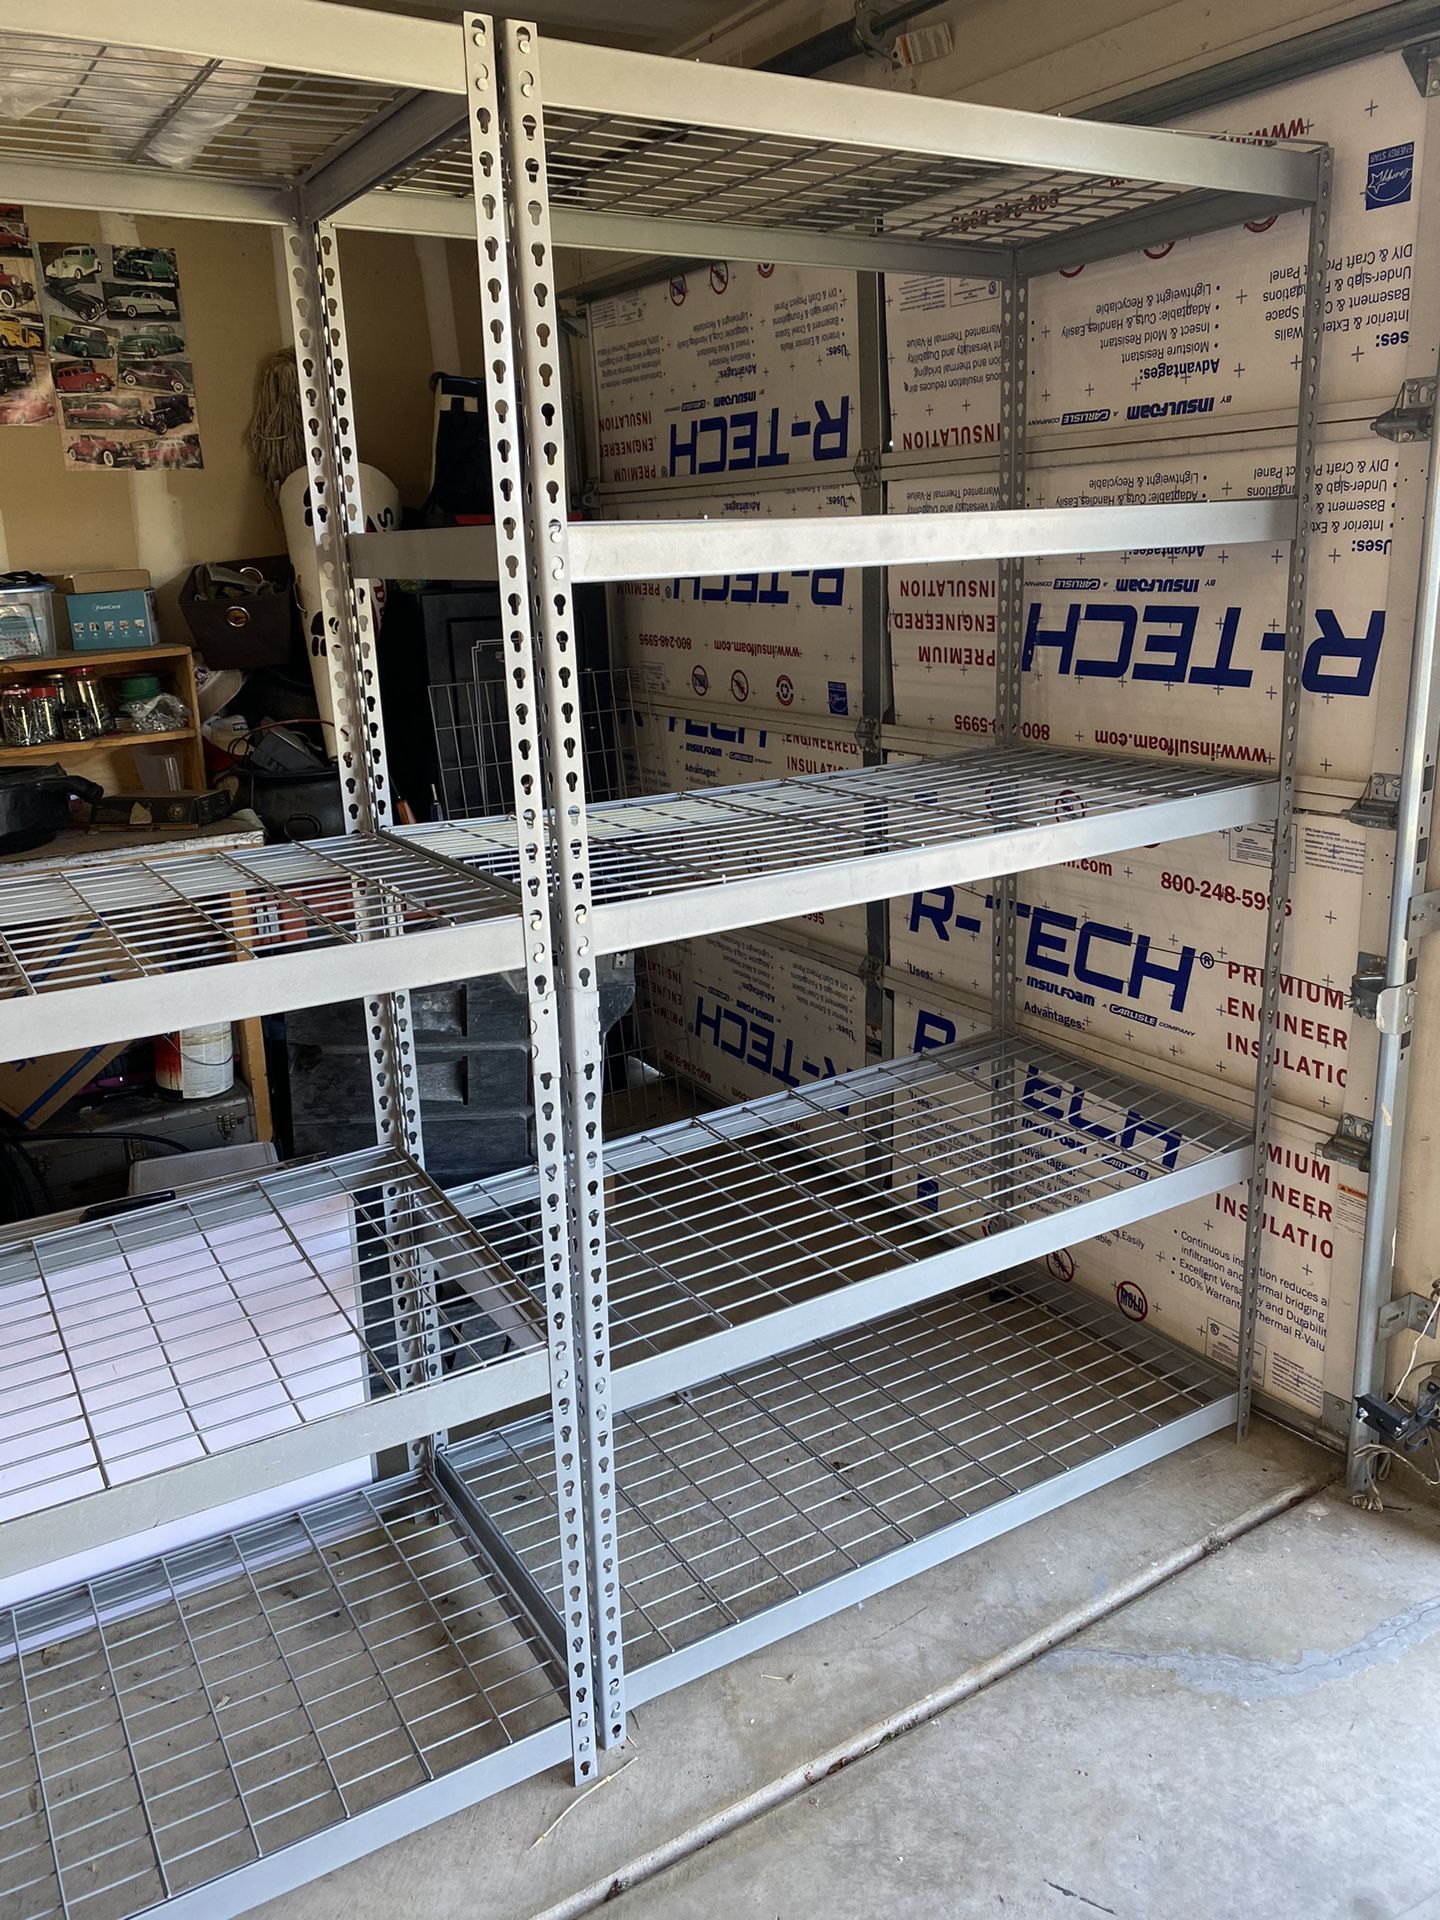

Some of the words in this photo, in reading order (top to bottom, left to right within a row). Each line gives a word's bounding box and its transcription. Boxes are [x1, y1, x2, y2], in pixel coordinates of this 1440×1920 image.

[1347, 251, 1376, 269] Craft
[1379, 248, 1388, 262] &
[1391, 243, 1412, 261] DIY
[1269, 266, 1300, 284] Panel
[1347, 265, 1412, 290] Under-slab
[1156, 283, 1212, 303] Lightweight
[1334, 279, 1344, 292] &
[1095, 296, 1144, 316] Recyclable
[1146, 294, 1153, 306] &
[1336, 299, 1345, 311] &
[1349, 288, 1410, 308] Basement
[1135, 312, 1157, 326] Cuts
[1158, 302, 1211, 322] Adaptable:
[1265, 305, 1299, 323] Space
[1364, 309, 1410, 328] Interior
[1061, 320, 1086, 339] Easily
[1125, 316, 1133, 327] &
[1179, 321, 1210, 337] Insect
[1353, 316, 1362, 330] &
[933, 330, 963, 345] Thermal
[1099, 333, 1142, 350] Resistant
[1144, 329, 1168, 345] Mold
[1170, 328, 1177, 339] &
[1274, 326, 1304, 341] Walls
[1375, 330, 1410, 349] ses:
[825, 344, 847, 357] Uses:
[906, 336, 933, 349] R-Value
[1166, 341, 1210, 357] Moisture
[941, 347, 955, 359] and
[1120, 346, 1165, 364] Resistant
[717, 363, 757, 380] Advantages:
[913, 364, 942, 378] bridging
[943, 361, 971, 375] thermal
[972, 358, 987, 371] and
[1138, 358, 1221, 380] Advantages:
[919, 379, 947, 392] reduces
[948, 375, 984, 388] insulation
[1220, 395, 1232, 404] BY
[598, 409, 652, 432] INSULATION
[1061, 409, 1110, 426] CARLISLE
[902, 423, 1000, 451] INSULATION
[613, 464, 657, 482] PREMIUM
[1253, 466, 1283, 480] Panel
[1326, 462, 1354, 477] Craft
[1357, 461, 1366, 473] &
[1368, 458, 1389, 473] DIY
[1089, 475, 1135, 490] Recyclable
[1137, 476, 1144, 487] &
[1146, 469, 1199, 488] Lightweight
[1326, 479, 1388, 494] Under-slab
[906, 491, 932, 502] R-Value
[932, 488, 961, 500] Thermal
[963, 486, 1000, 499] Warranted
[1314, 483, 1323, 495] &
[723, 500, 761, 512] Advantages:
[825, 496, 846, 507] Uses:
[1055, 494, 1079, 508] Easily
[1117, 494, 1125, 506] &
[1316, 502, 1325, 514] &
[1327, 500, 1386, 514] Basement
[1331, 521, 1340, 534] &
[1343, 520, 1384, 533] Interior
[616, 583, 660, 597] PREMIUM
[899, 579, 996, 598] INSULATION
[1023, 580, 1053, 588] COMPAN
[1053, 577, 1101, 591] CARLISLE
[1204, 579, 1216, 587] BY
[894, 613, 996, 633] ENGINEERED
[638, 633, 692, 651] 800-248-5995
[714, 638, 800, 659] www.insulfoam.com
[1021, 602, 1386, 697] R-TECH
[918, 645, 996, 667] PREMIUM
[1094, 730, 1267, 764] www.insulfoam.com
[787, 756, 848, 774] INSULATI
[1161, 872, 1292, 917] 800-248-595
[908, 962, 933, 981] Uses:
[1227, 961, 1344, 1010] PRMIUM
[1024, 1000, 1086, 1030] Advantages:
[1109, 1003, 1157, 1027] CARLISLE
[1158, 1021, 1196, 1037] COMPANY
[1227, 996, 1348, 1050] ENINEER
[1267, 1143, 1330, 1184] MIUM
[1121, 1229, 1146, 1250] Easily
[1180, 1230, 1230, 1261] Continuous
[1279, 1278, 1319, 1303] reduces
[1179, 1258, 1218, 1284] Excellent
[1265, 1301, 1284, 1316] and
[1179, 1272, 1204, 1291] 100%
[1205, 1285, 1242, 1310] Warrant
[1181, 1245, 1225, 1273] infiltration
[1285, 1294, 1325, 1323] bridging
